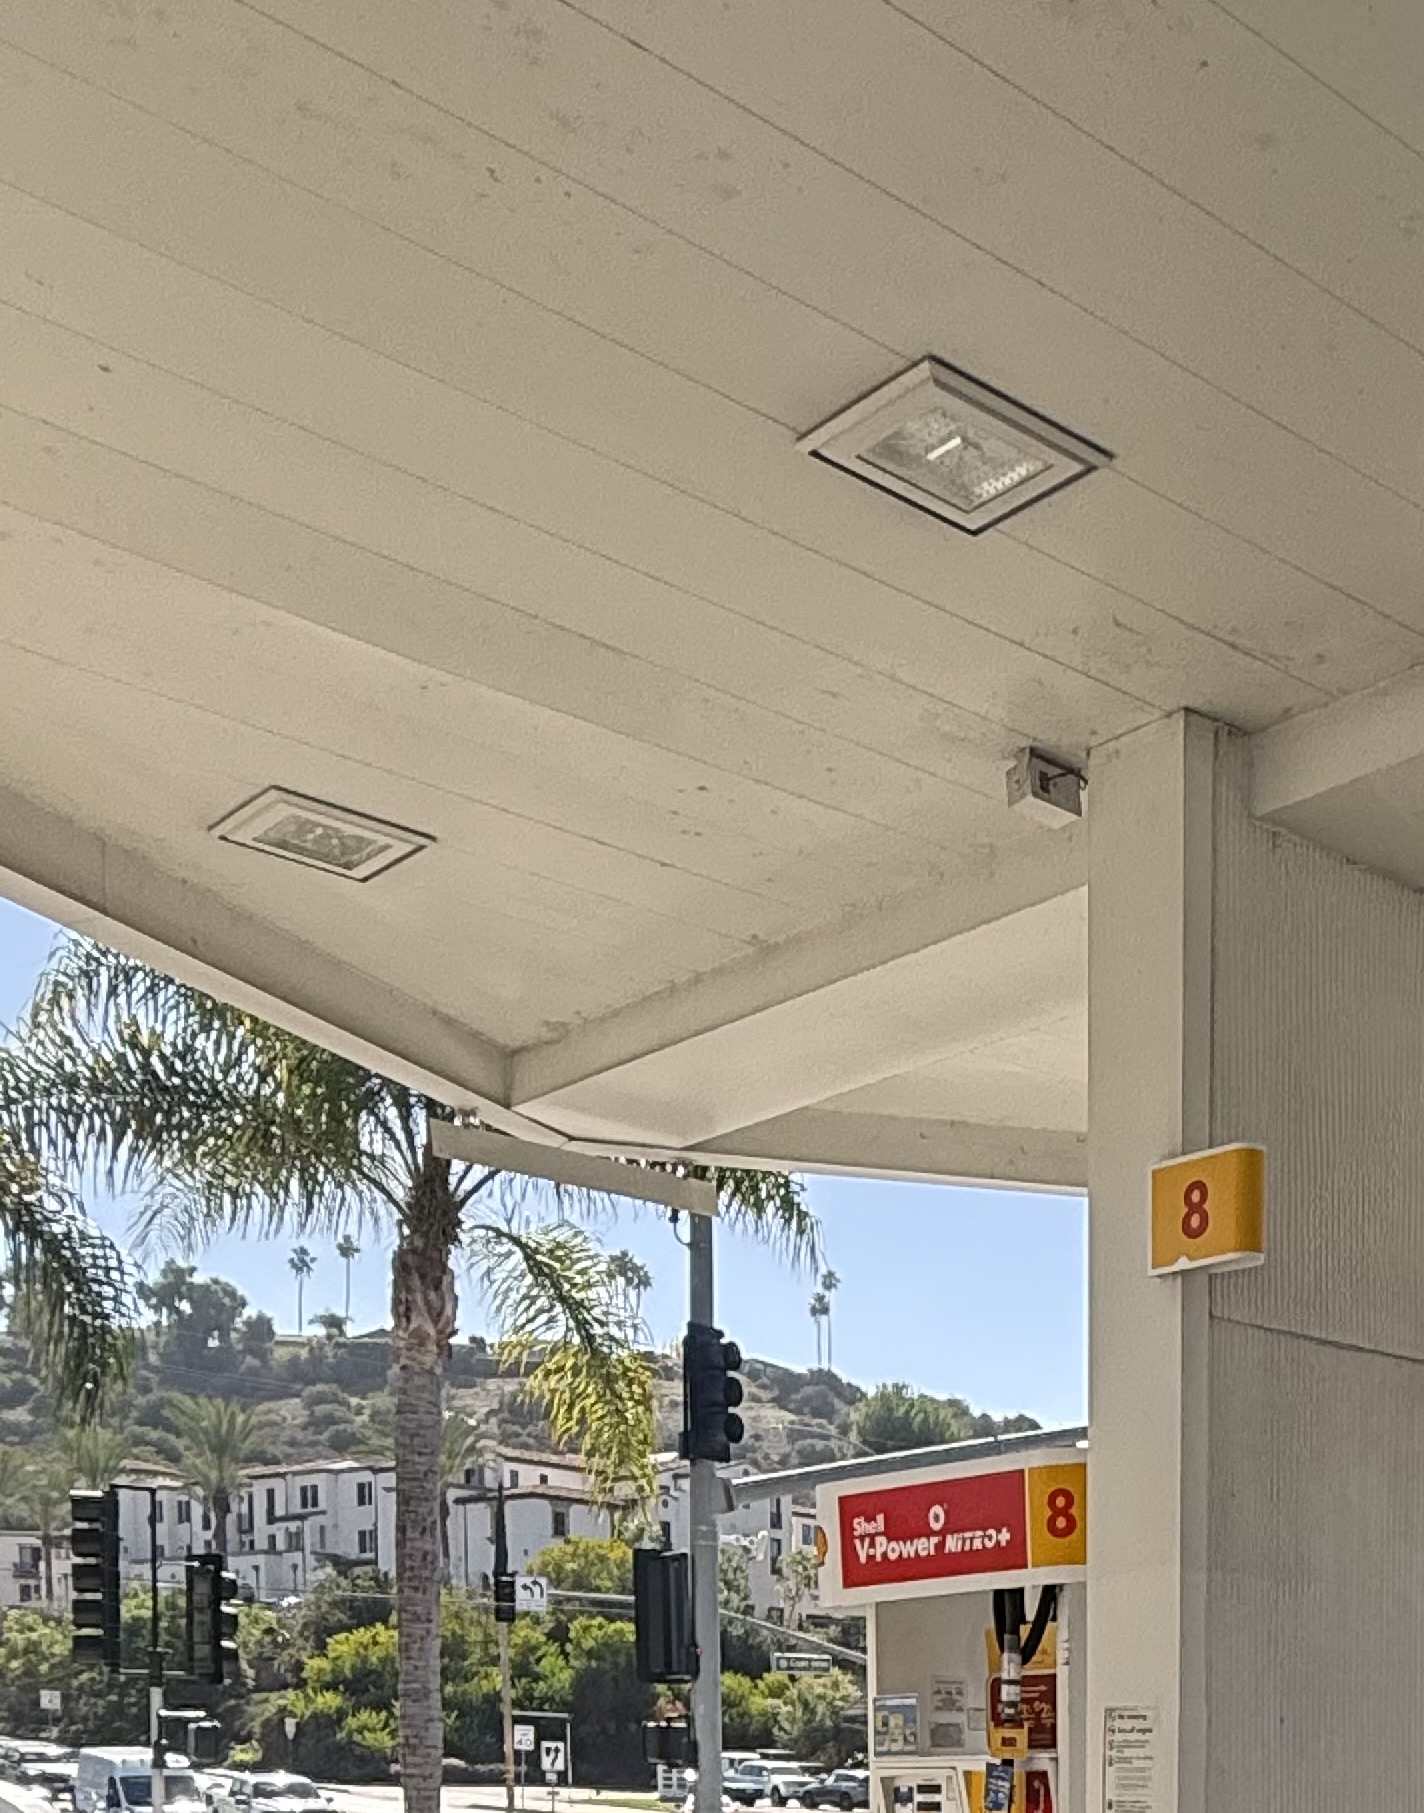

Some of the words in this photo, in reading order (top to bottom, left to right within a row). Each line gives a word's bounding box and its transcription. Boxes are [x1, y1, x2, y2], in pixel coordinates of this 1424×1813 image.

[1182, 1180, 1209, 1239] 8
[853, 1513, 885, 1536] Shell
[1047, 1488, 1077, 1538] 8
[854, 1533, 939, 1564] V-Power
